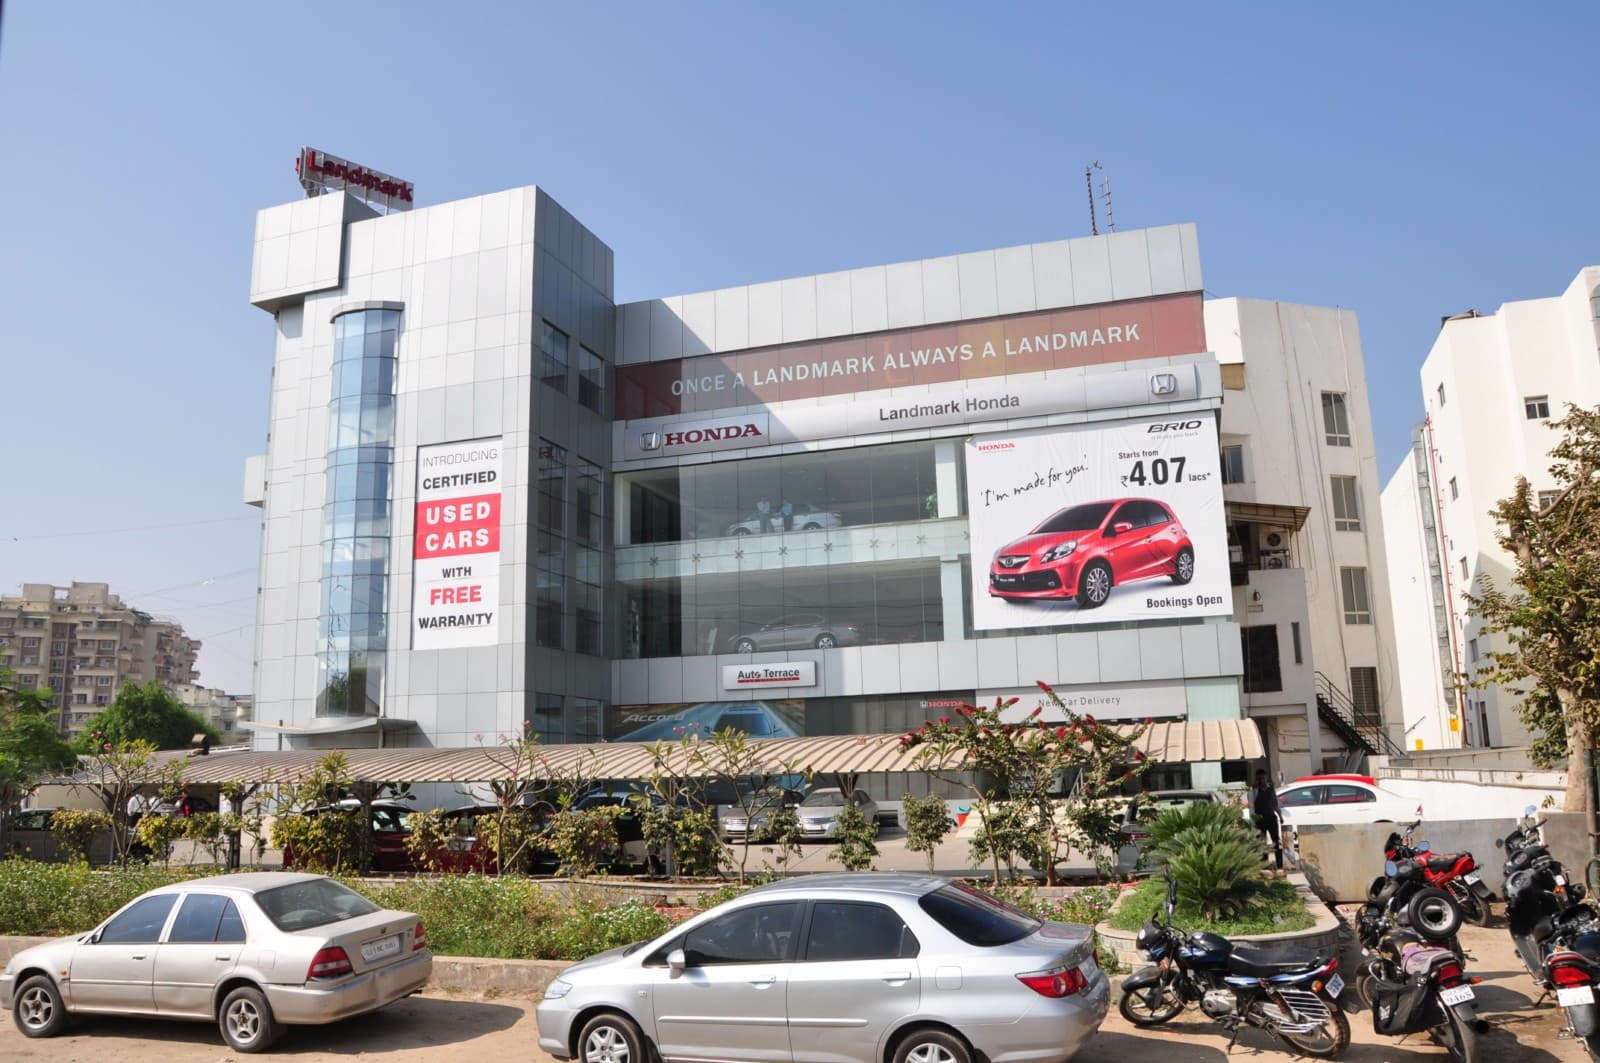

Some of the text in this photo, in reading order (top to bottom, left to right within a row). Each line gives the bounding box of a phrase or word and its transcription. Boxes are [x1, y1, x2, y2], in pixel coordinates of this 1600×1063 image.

[307, 150, 413, 202] Landmark
[671, 323, 1141, 396] ONCE A LANDMARK ALWAYS A LANDMARK
[879, 394, 1020, 421] Landmark Honda
[664, 424, 762, 446] HONDA
[1147, 420, 1202, 433] BRIO
[978, 442, 1015, 452] HONDA
[1118, 449, 1159, 460] Starts from
[423, 449, 498, 468] INTRODUCING
[423, 470, 497, 490] CERTIFIED
[1013, 471, 1046, 495] made
[1048, 467, 1062, 488] for
[426, 502, 491, 525] USED
[425, 528, 490, 552] CARS
[442, 566, 472, 579] WITH
[430, 585, 482, 606] FREE
[1146, 595, 1223, 608] Bookings Open
[418, 612, 493, 629] WARRANTY
[738, 668, 800, 679] Auto Terrace
[1080, 696, 1121, 706] Delivery
[623, 712, 687, 723] Accord
